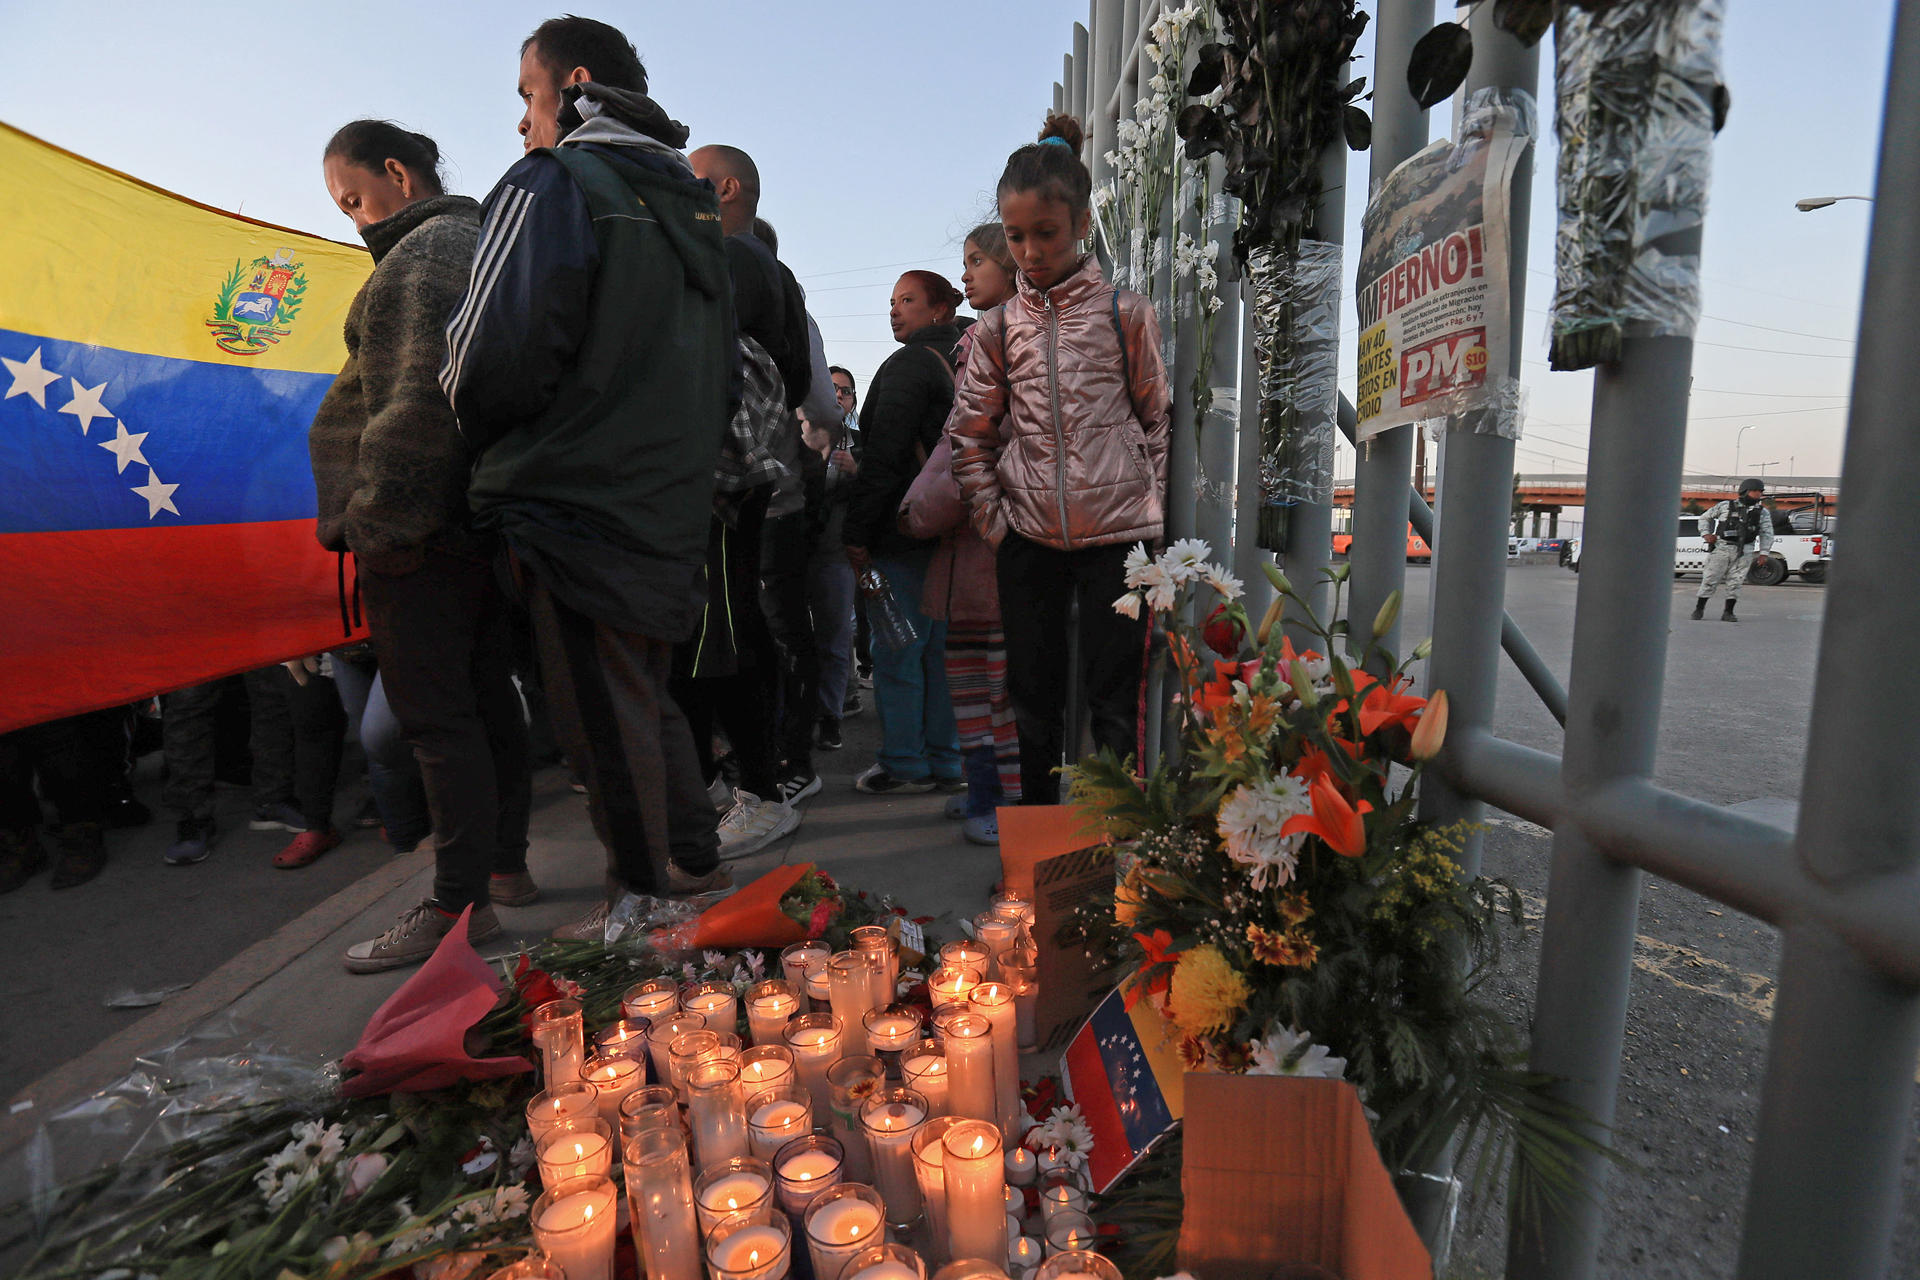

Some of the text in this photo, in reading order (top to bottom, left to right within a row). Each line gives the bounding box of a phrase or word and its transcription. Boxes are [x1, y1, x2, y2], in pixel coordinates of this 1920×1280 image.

[1439, 285, 1477, 301] extranjeros
[1478, 283, 1488, 292] en
[1448, 293, 1485, 307] Migración
[1467, 303, 1482, 312] hay
[1372, 329, 1386, 352] 40
[1402, 334, 1481, 399] PM
[1465, 351, 1487, 367] $10
[1383, 367, 1398, 392] EN
